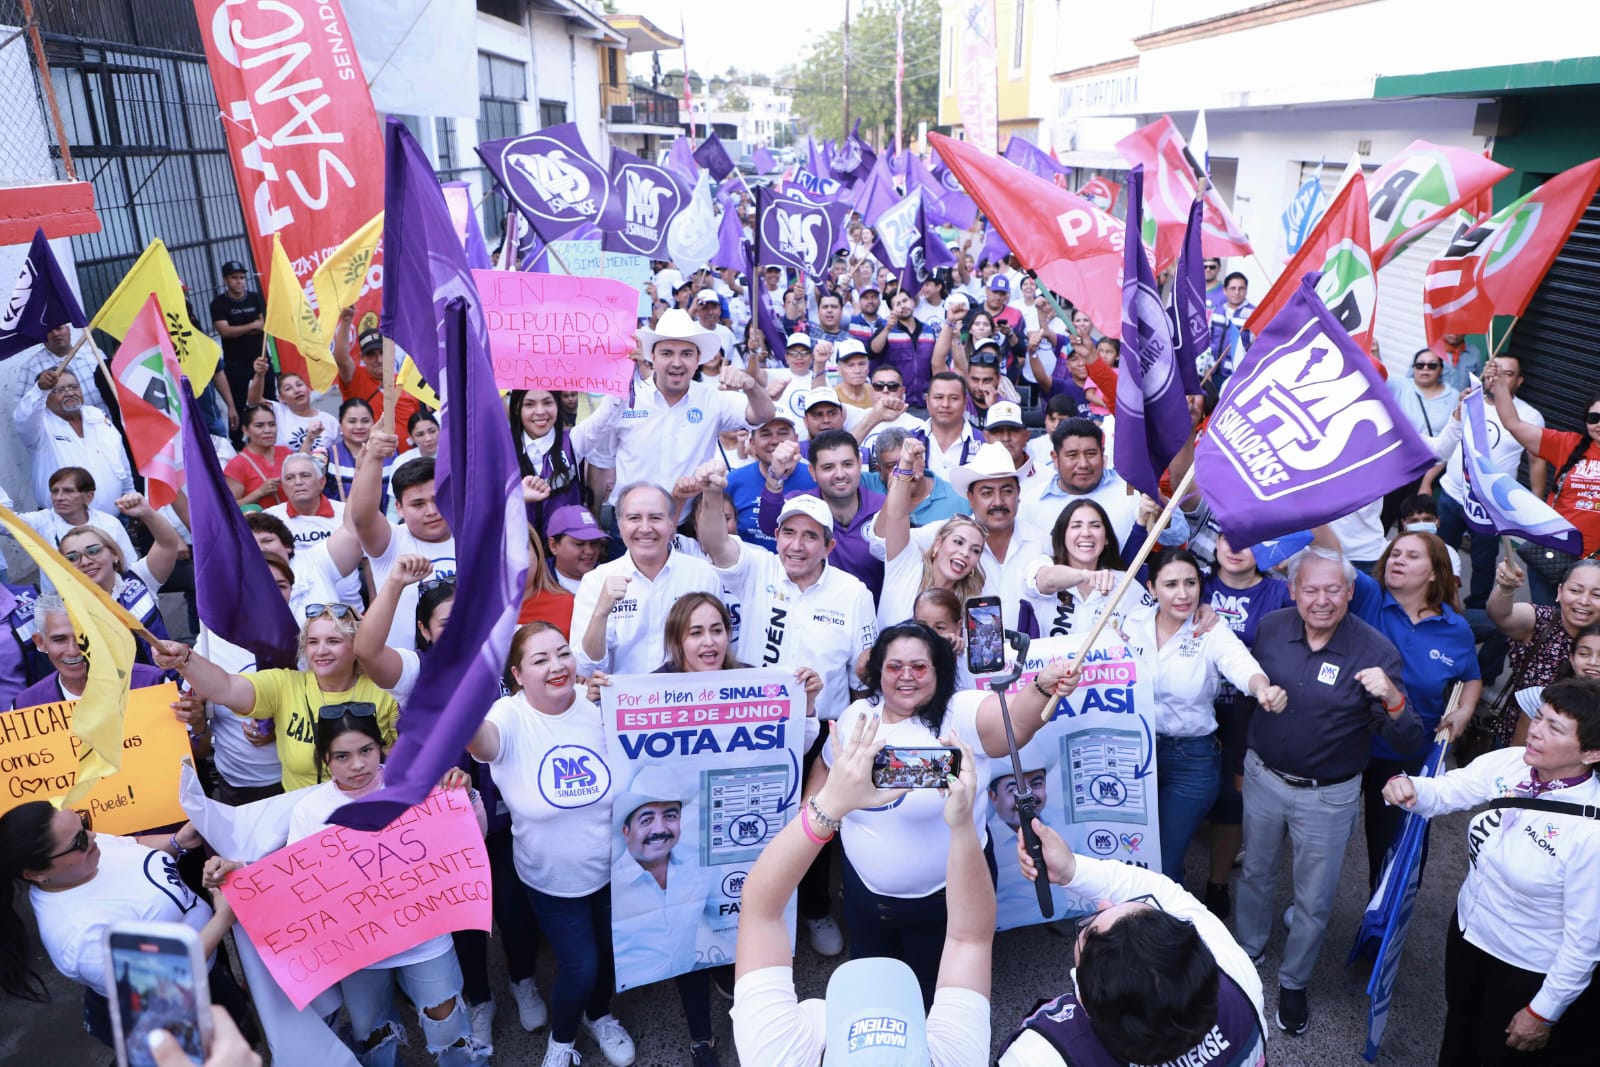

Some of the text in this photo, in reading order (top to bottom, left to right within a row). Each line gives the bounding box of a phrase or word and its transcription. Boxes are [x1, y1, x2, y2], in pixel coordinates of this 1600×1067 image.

[315, 0, 356, 81] SENAD
[506, 150, 590, 202] PAS
[625, 168, 673, 228] PAS
[1056, 206, 1127, 248] PA
[486, 310, 610, 335] DIPUTADO
[517, 333, 628, 356] FEDERAL
[545, 358, 577, 374] PAS
[523, 375, 623, 393] MOCHICAHUI
[1234, 332, 1396, 471] PAS
[1214, 403, 1290, 488] SINALOENSE
[293, 530, 332, 544] ALOM
[617, 693, 642, 706] Por
[648, 692, 660, 705] el
[664, 690, 693, 703] bien
[699, 687, 716, 702] de
[1079, 680, 1137, 715] ASÍ
[286, 711, 316, 745] CAL
[624, 704, 783, 727] ESTE 2 DE JUNIO
[618, 717, 790, 760] VOTA ASÍ
[552, 755, 597, 789] PAS
[1098, 781, 1119, 797] PAS
[89, 784, 136, 818] Puede!
[556, 785, 601, 798] SINALOENSE
[232, 868, 276, 902] SE
[273, 847, 323, 878] VE,
[320, 827, 360, 859] SE
[289, 828, 427, 906] EL PAS
[719, 902, 742, 917] FA
[263, 908, 339, 956] ESTA
[287, 879, 490, 984] CUENTA CONMIGO
